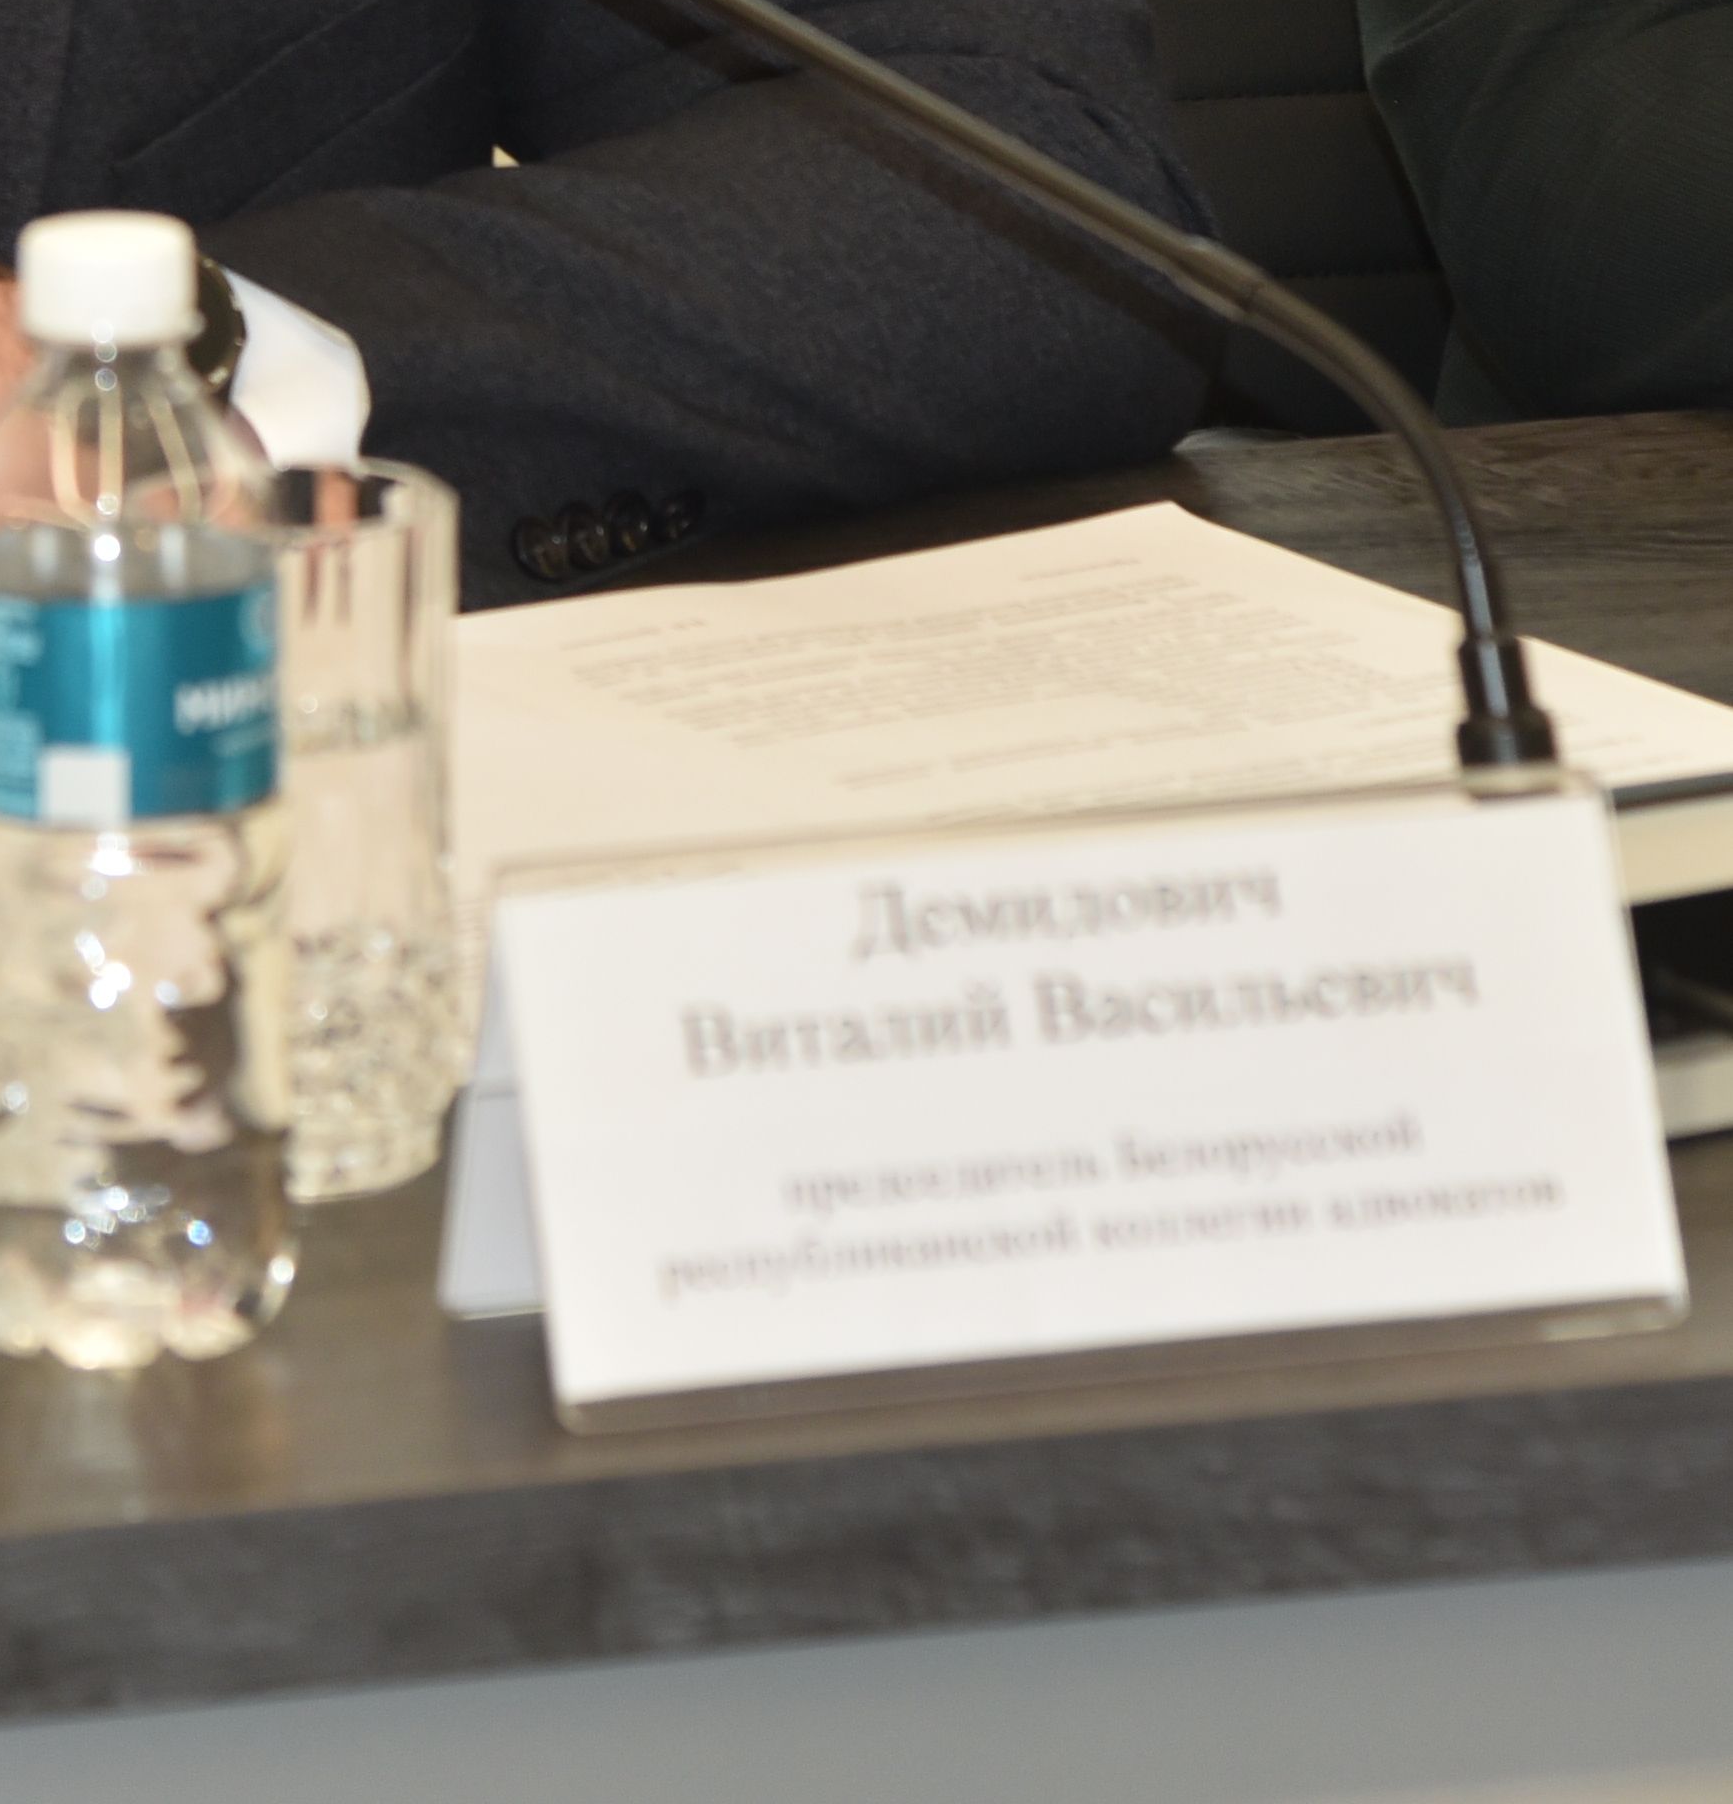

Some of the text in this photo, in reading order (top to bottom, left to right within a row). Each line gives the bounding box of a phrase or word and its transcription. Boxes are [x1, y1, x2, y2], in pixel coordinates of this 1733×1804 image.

[852, 865, 1282, 962] Демидович
[678, 953, 1481, 1079] Виталий Васильевич
